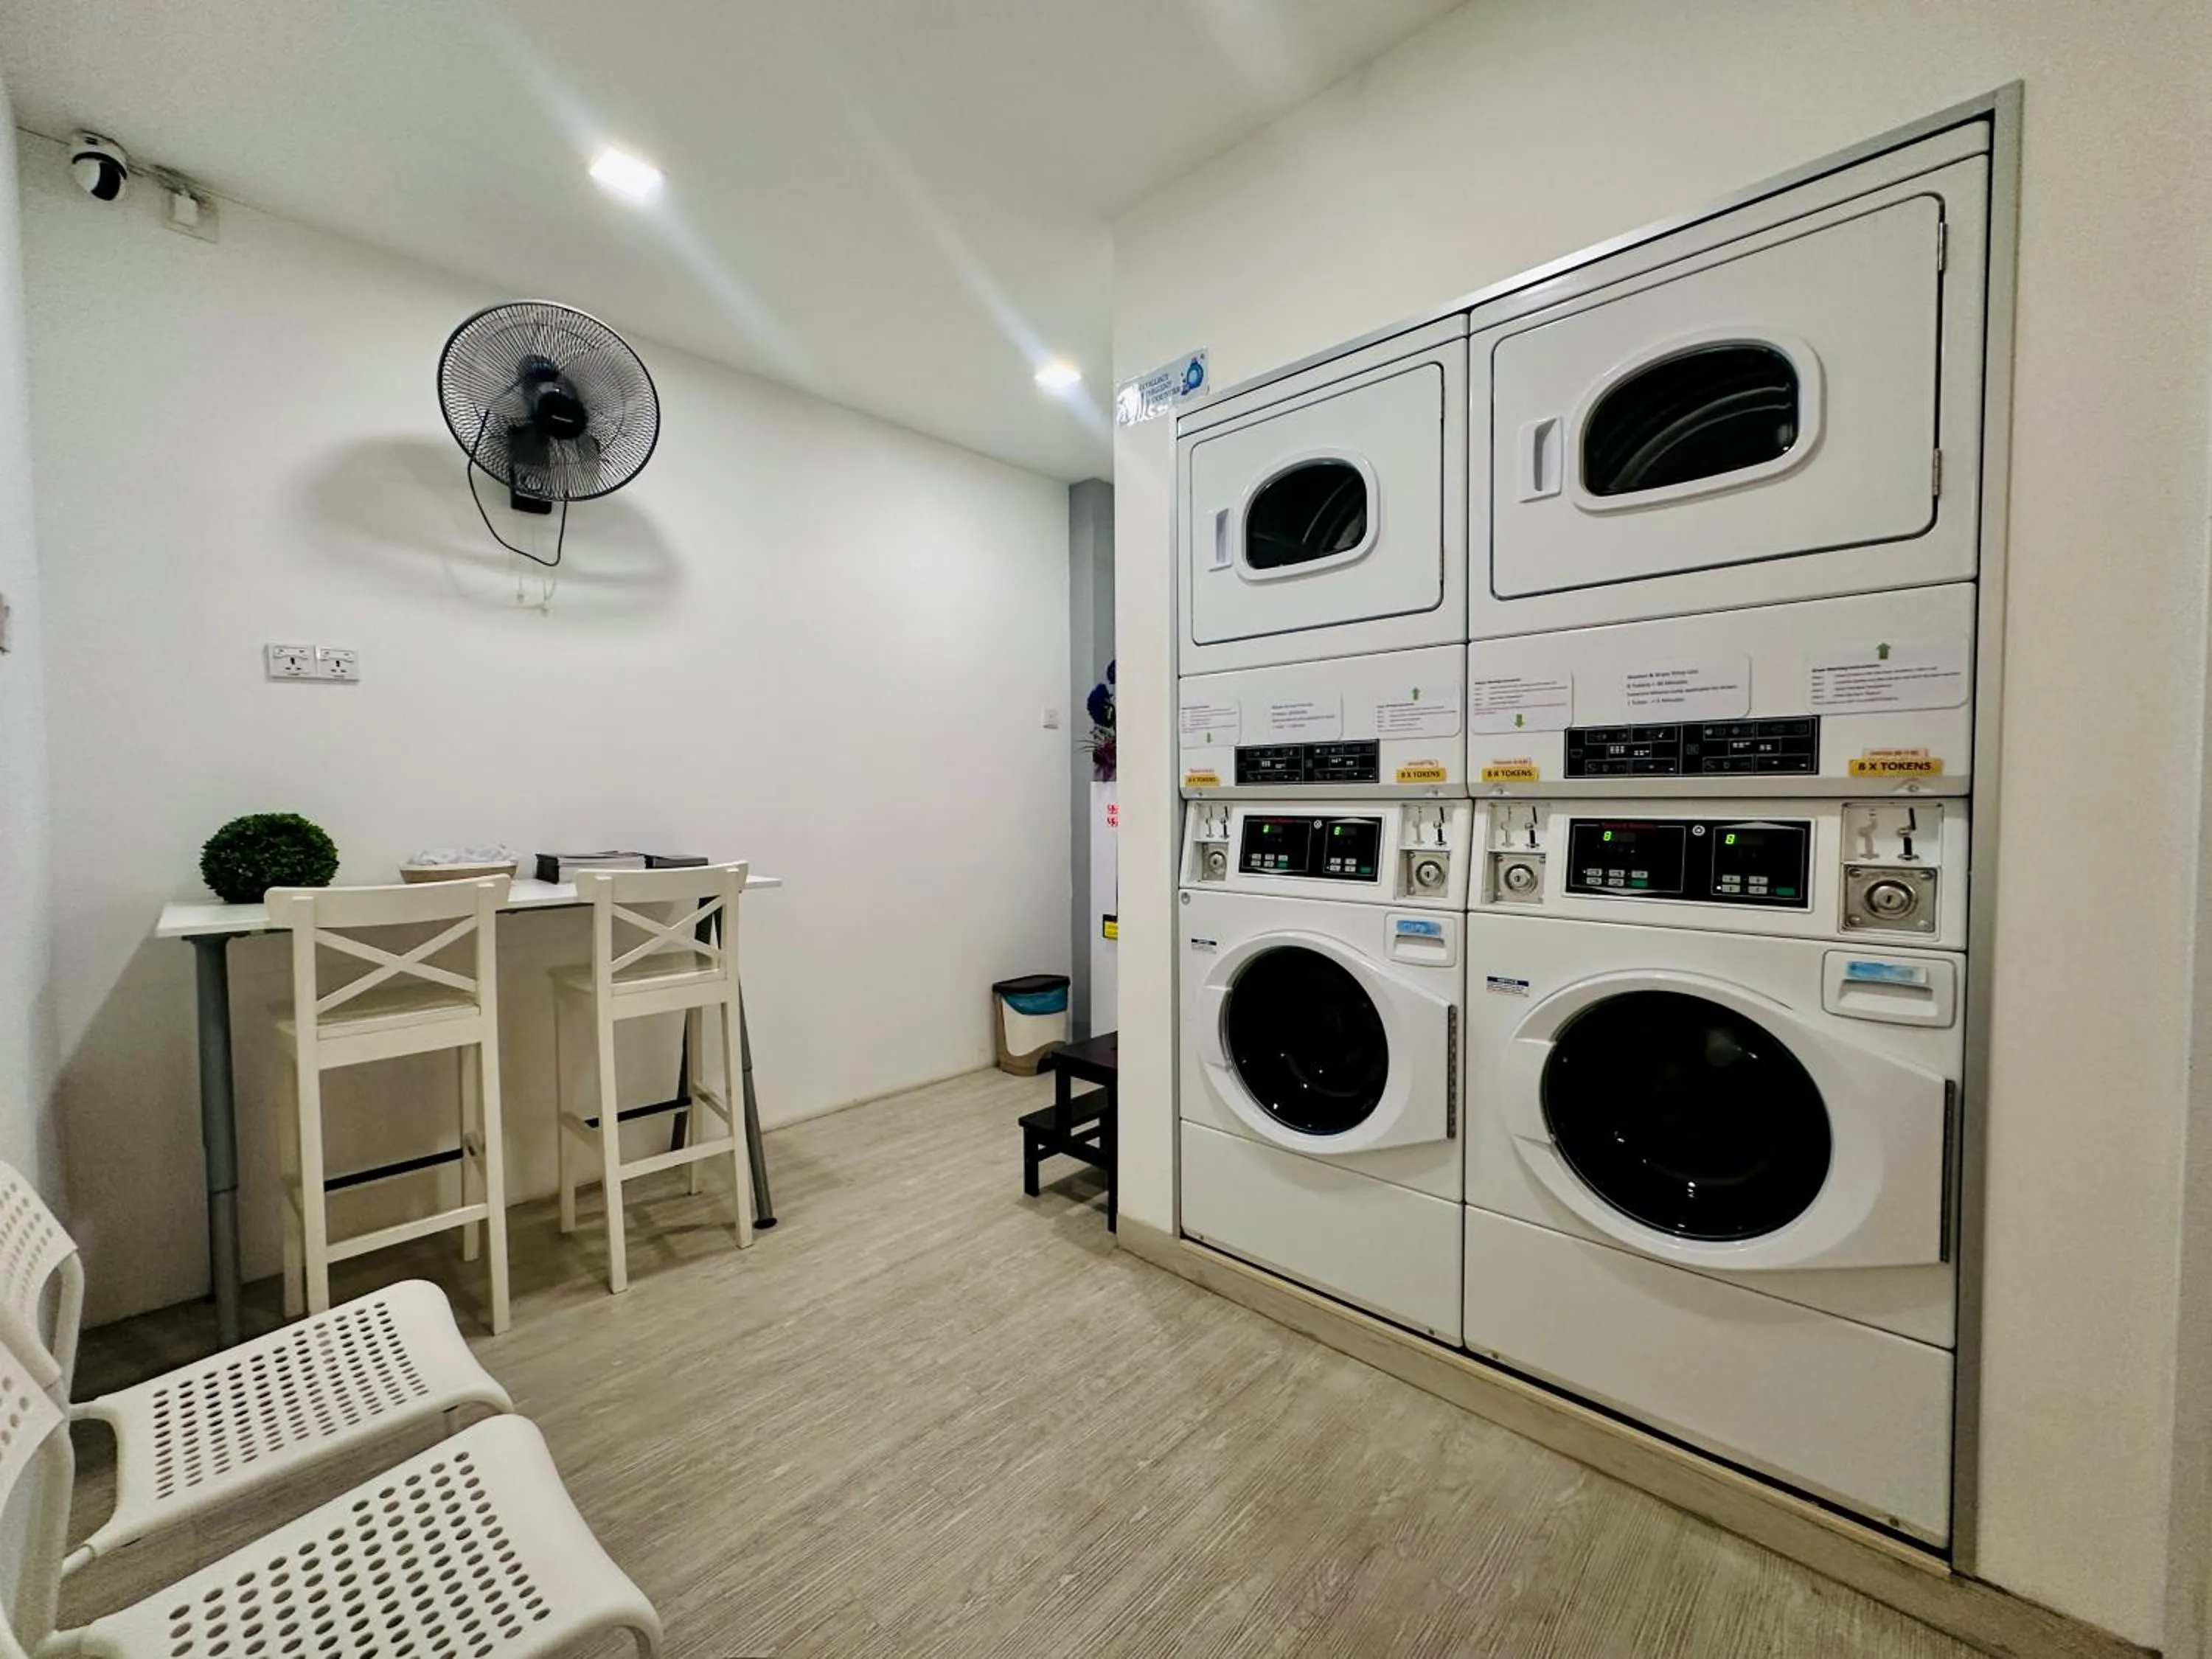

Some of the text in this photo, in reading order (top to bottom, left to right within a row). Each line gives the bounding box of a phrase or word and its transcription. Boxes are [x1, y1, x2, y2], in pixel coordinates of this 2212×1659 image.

[1868, 762, 1877, 771] X
[1880, 761, 1933, 771] TOKENS
[1500, 769, 1534, 777] TOKENS
